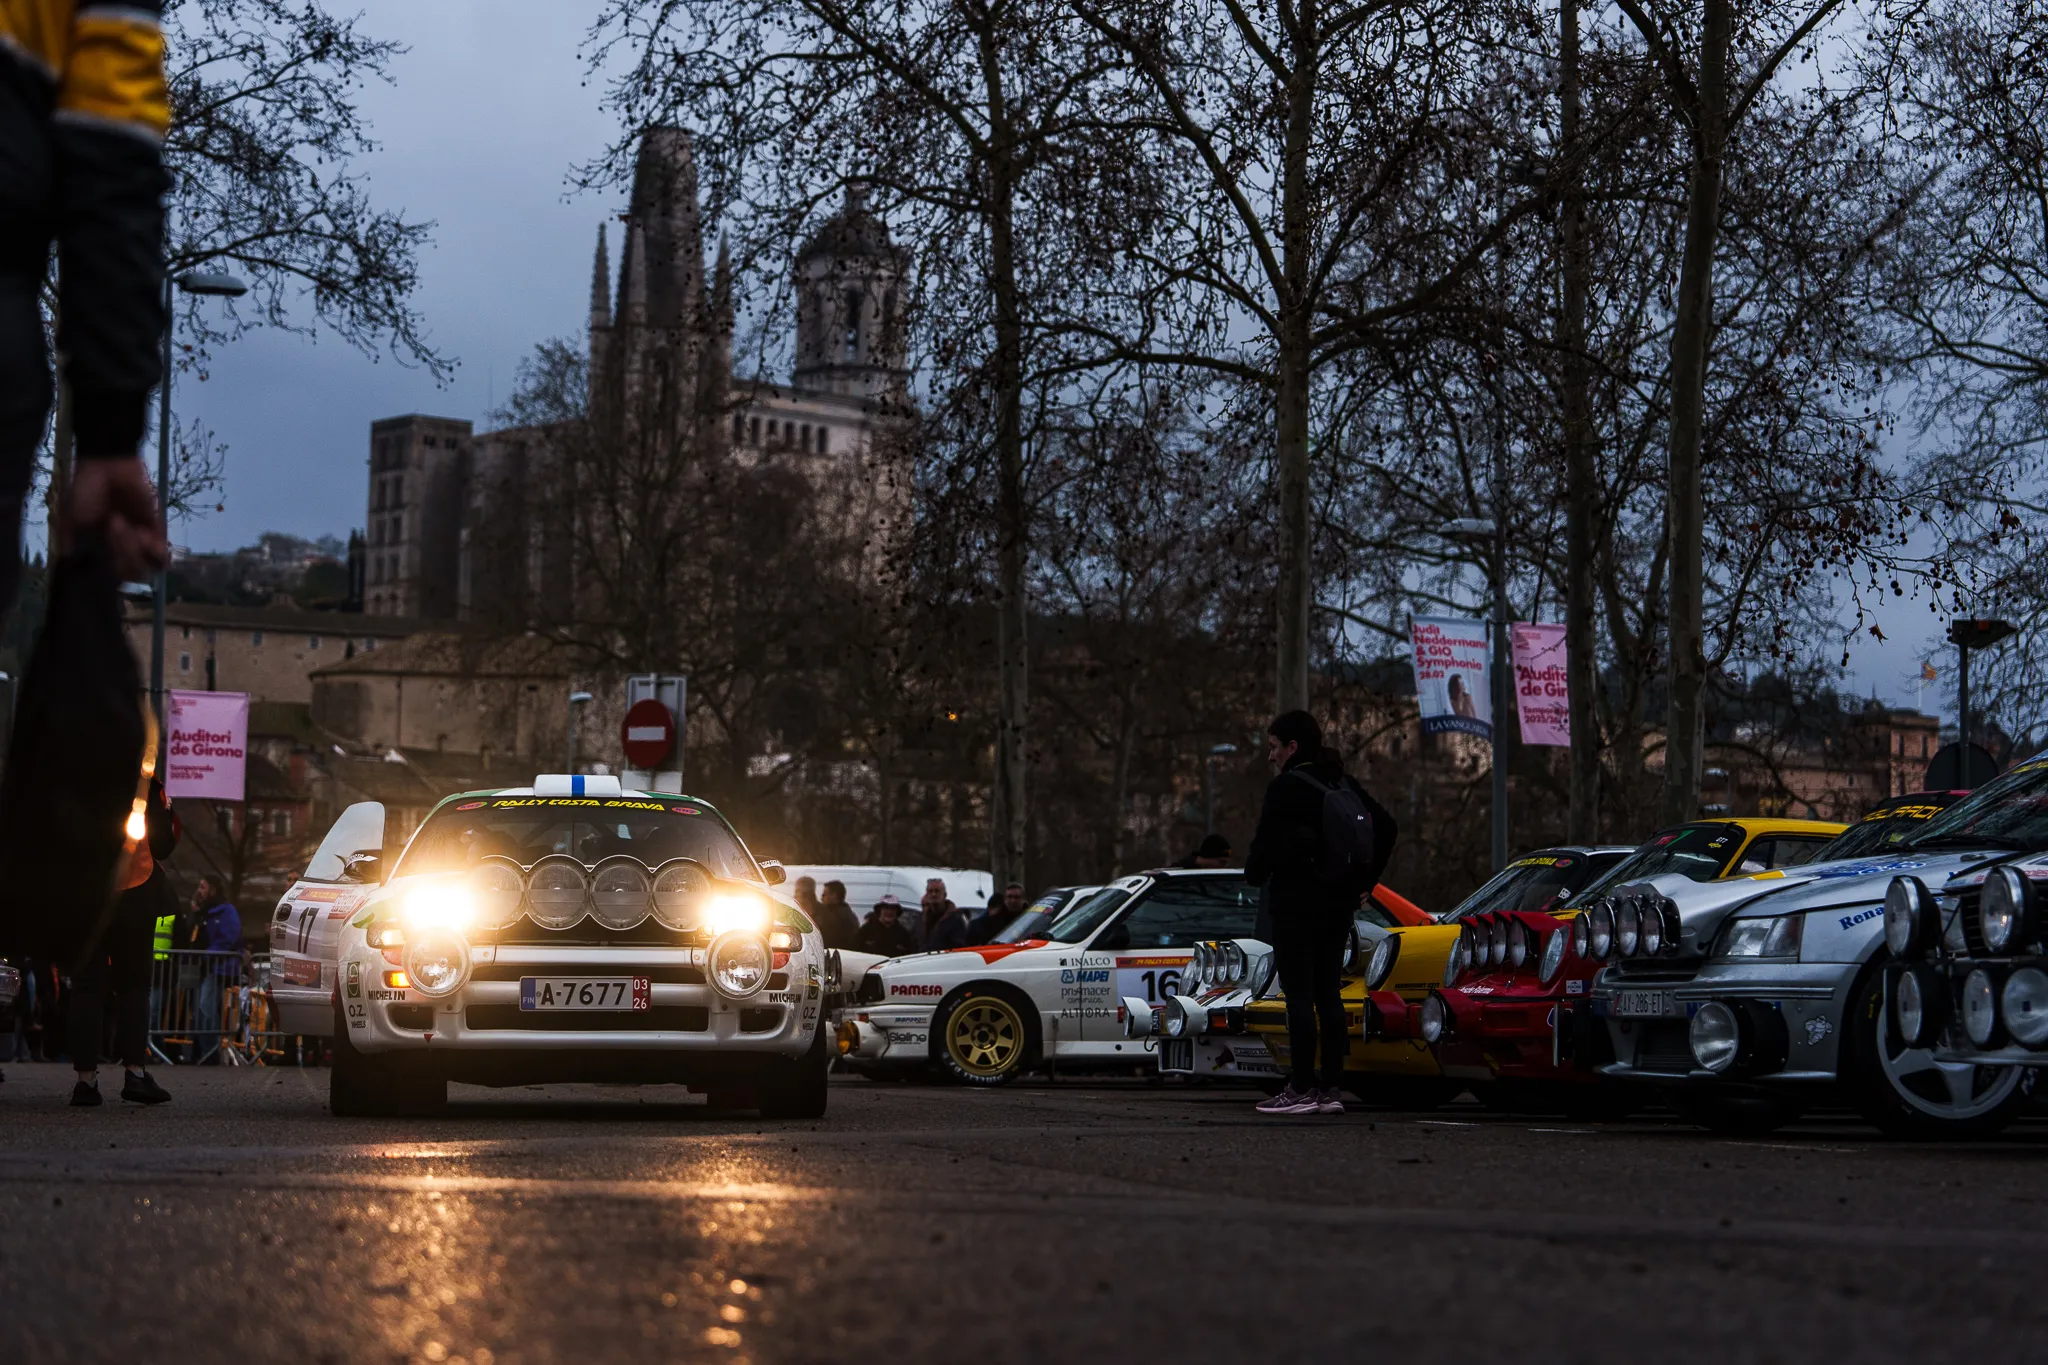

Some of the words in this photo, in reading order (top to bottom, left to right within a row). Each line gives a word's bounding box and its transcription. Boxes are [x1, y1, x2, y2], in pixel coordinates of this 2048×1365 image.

[1413, 624, 1440, 635] Judit
[1428, 645, 1451, 657] GIO
[1417, 656, 1482, 671] Symphonia
[1520, 665, 1567, 681] Audito
[1521, 681, 1542, 696] de
[1544, 682, 1568, 697] Gir
[171, 729, 232, 744] Auditori
[170, 743, 190, 756] de
[192, 743, 243, 758] Girona
[492, 799, 547, 808] RALLY
[548, 799, 601, 807] COSTA
[603, 801, 665, 811] BRAVA
[1838, 906, 1885, 931] Rena
[298, 907, 320, 954] 17
[1071, 957, 1110, 967] INALCO
[1076, 970, 1110, 983] MAPEI
[633, 979, 648, 991] 03
[891, 984, 943, 996] PAMESA
[1141, 970, 1181, 1002] 16
[368, 990, 406, 1001] MICHELIN
[522, 996, 535, 1004] FIN
[541, 982, 627, 1005] A-7677
[769, 993, 802, 1004] MICHELIN
[633, 997, 647, 1009] 26
[348, 1004, 367, 1017] O.Z.
[803, 1006, 817, 1020] O.Z.
